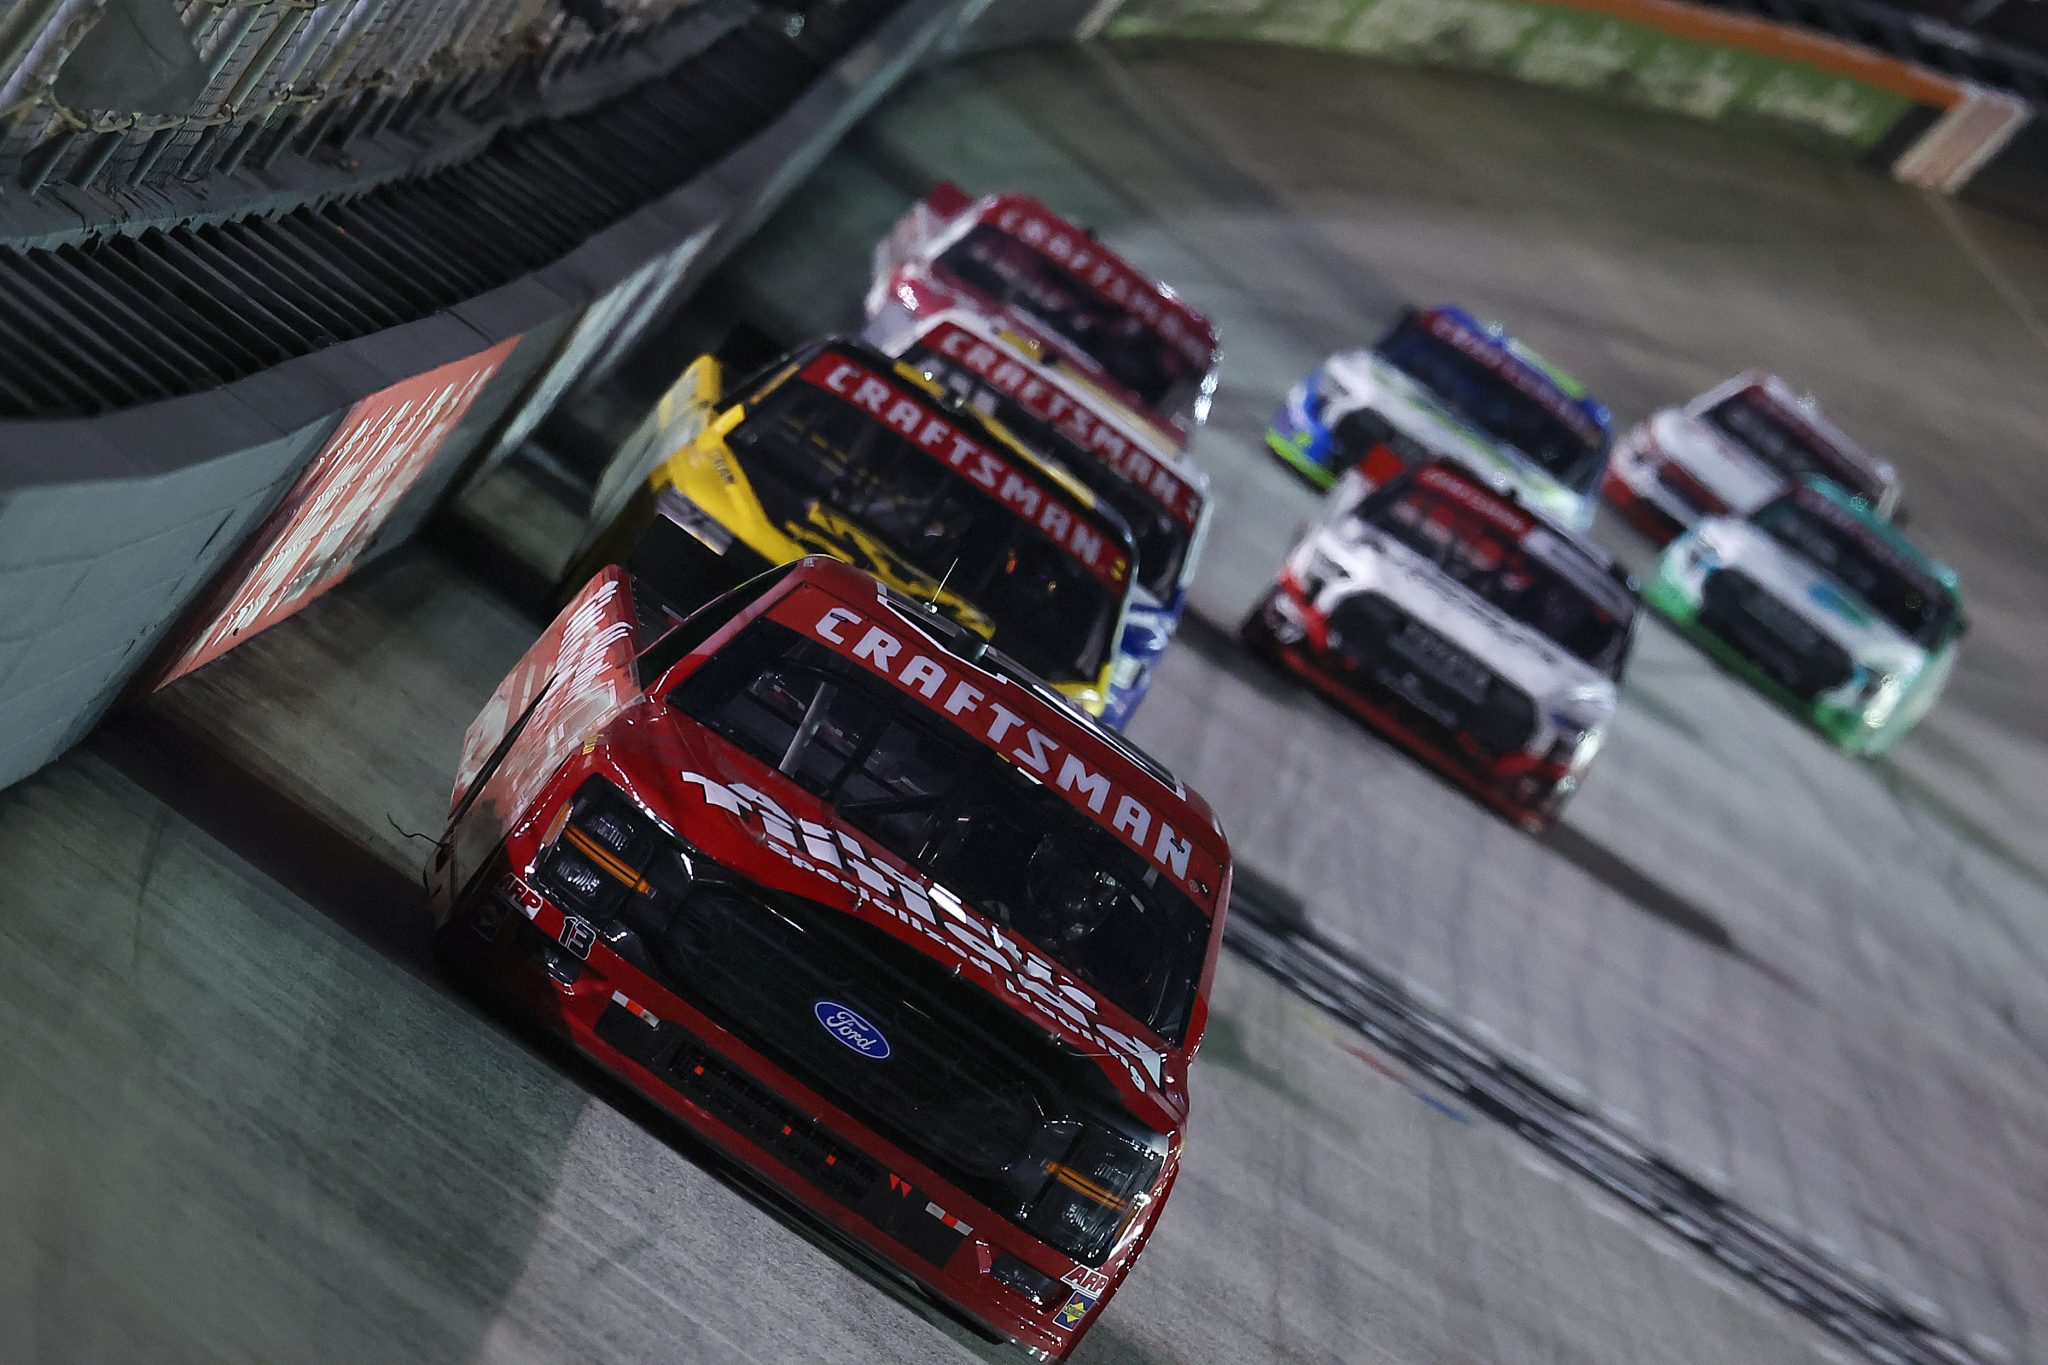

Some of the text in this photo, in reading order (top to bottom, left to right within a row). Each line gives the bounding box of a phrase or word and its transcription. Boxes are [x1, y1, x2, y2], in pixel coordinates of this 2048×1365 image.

[825, 362, 1103, 564] CRAFTSMAN
[942, 330, 1180, 504] CRAFTSMAN
[815, 606, 1193, 881] CRAFTSMAN
[559, 915, 597, 960] 13
[681, 771, 1162, 1088] Tiltload
[728, 782, 1099, 1015] Atlantic
[767, 840, 1146, 1093] Specialized Hauling
[826, 1011, 877, 1050] Ford
[1062, 1266, 1109, 1297] ARP
